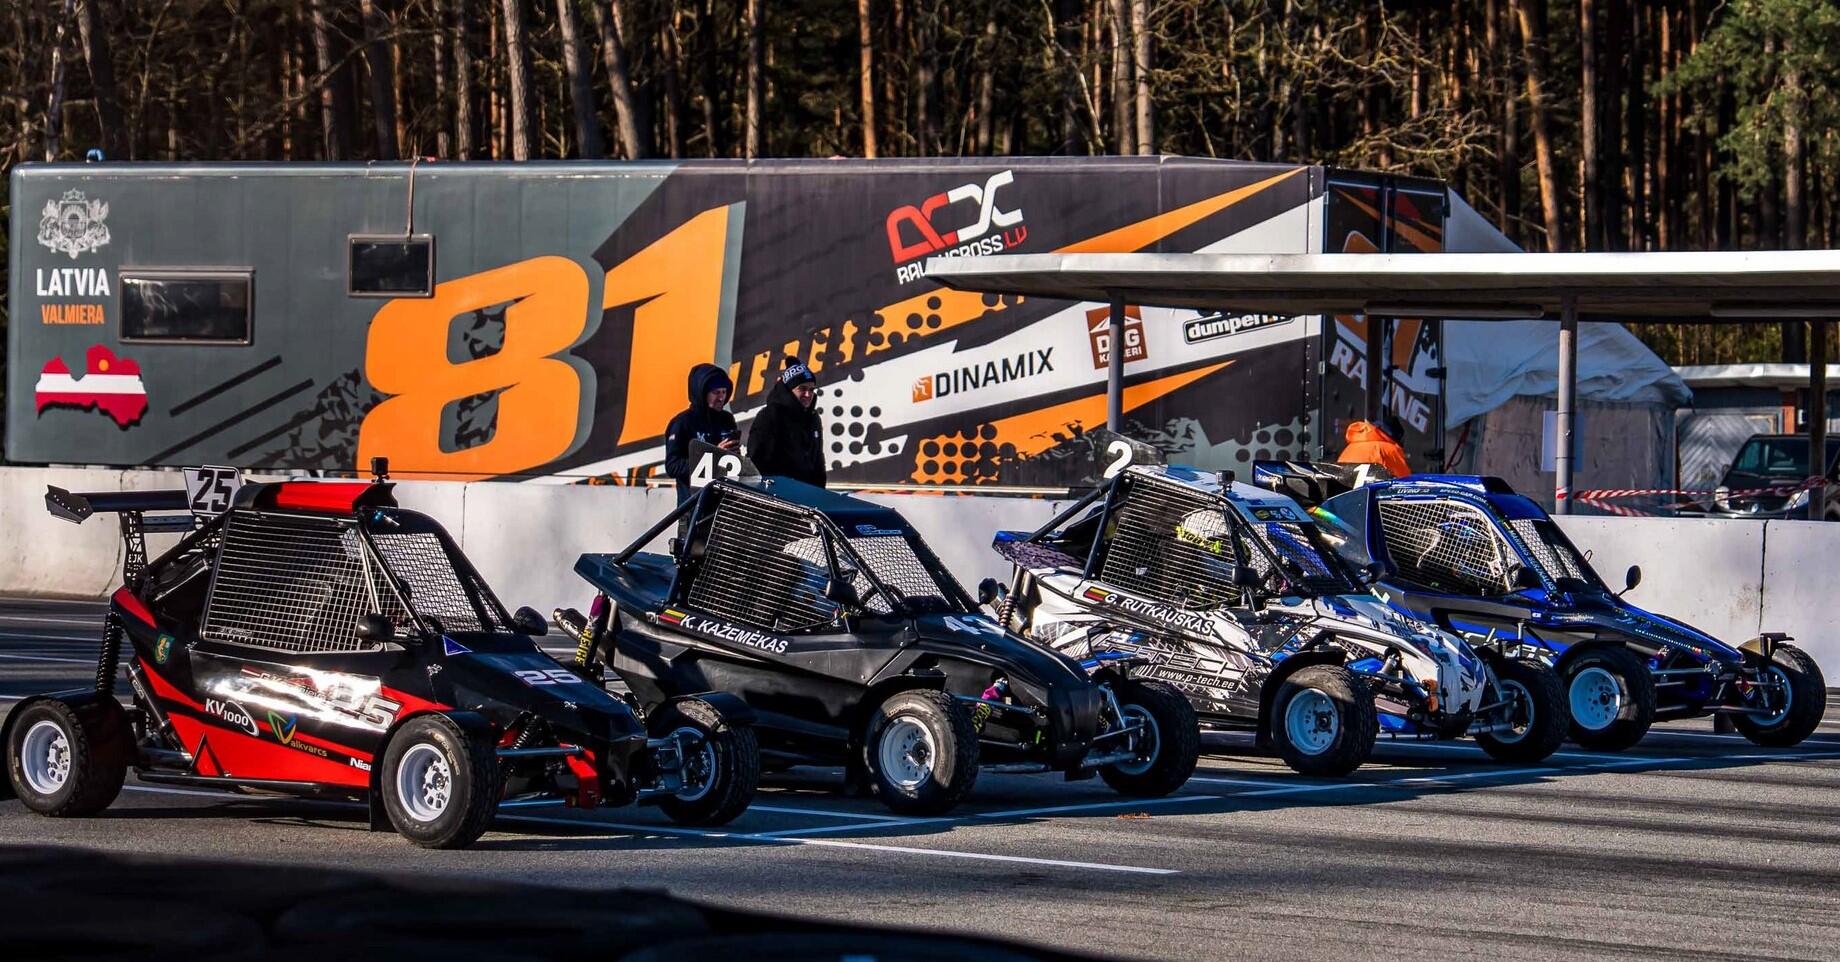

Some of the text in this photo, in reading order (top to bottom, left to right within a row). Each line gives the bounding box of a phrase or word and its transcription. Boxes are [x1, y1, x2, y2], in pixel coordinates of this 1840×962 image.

[36, 268, 111, 296] LATVIA
[41, 304, 105, 324] VALMIERA
[356, 204, 729, 482] 81
[936, 346, 1054, 398] DINAMIX
[690, 452, 742, 488] 43
[1104, 440, 1133, 478] 2
[193, 469, 236, 512] 25
[1104, 594, 1213, 634] G. RUTKAUSKAS
[680, 614, 789, 654] K. KAŽEMĖKAS
[515, 669, 582, 685] 25
[1159, 669, 1235, 690] www.p-tech.ee
